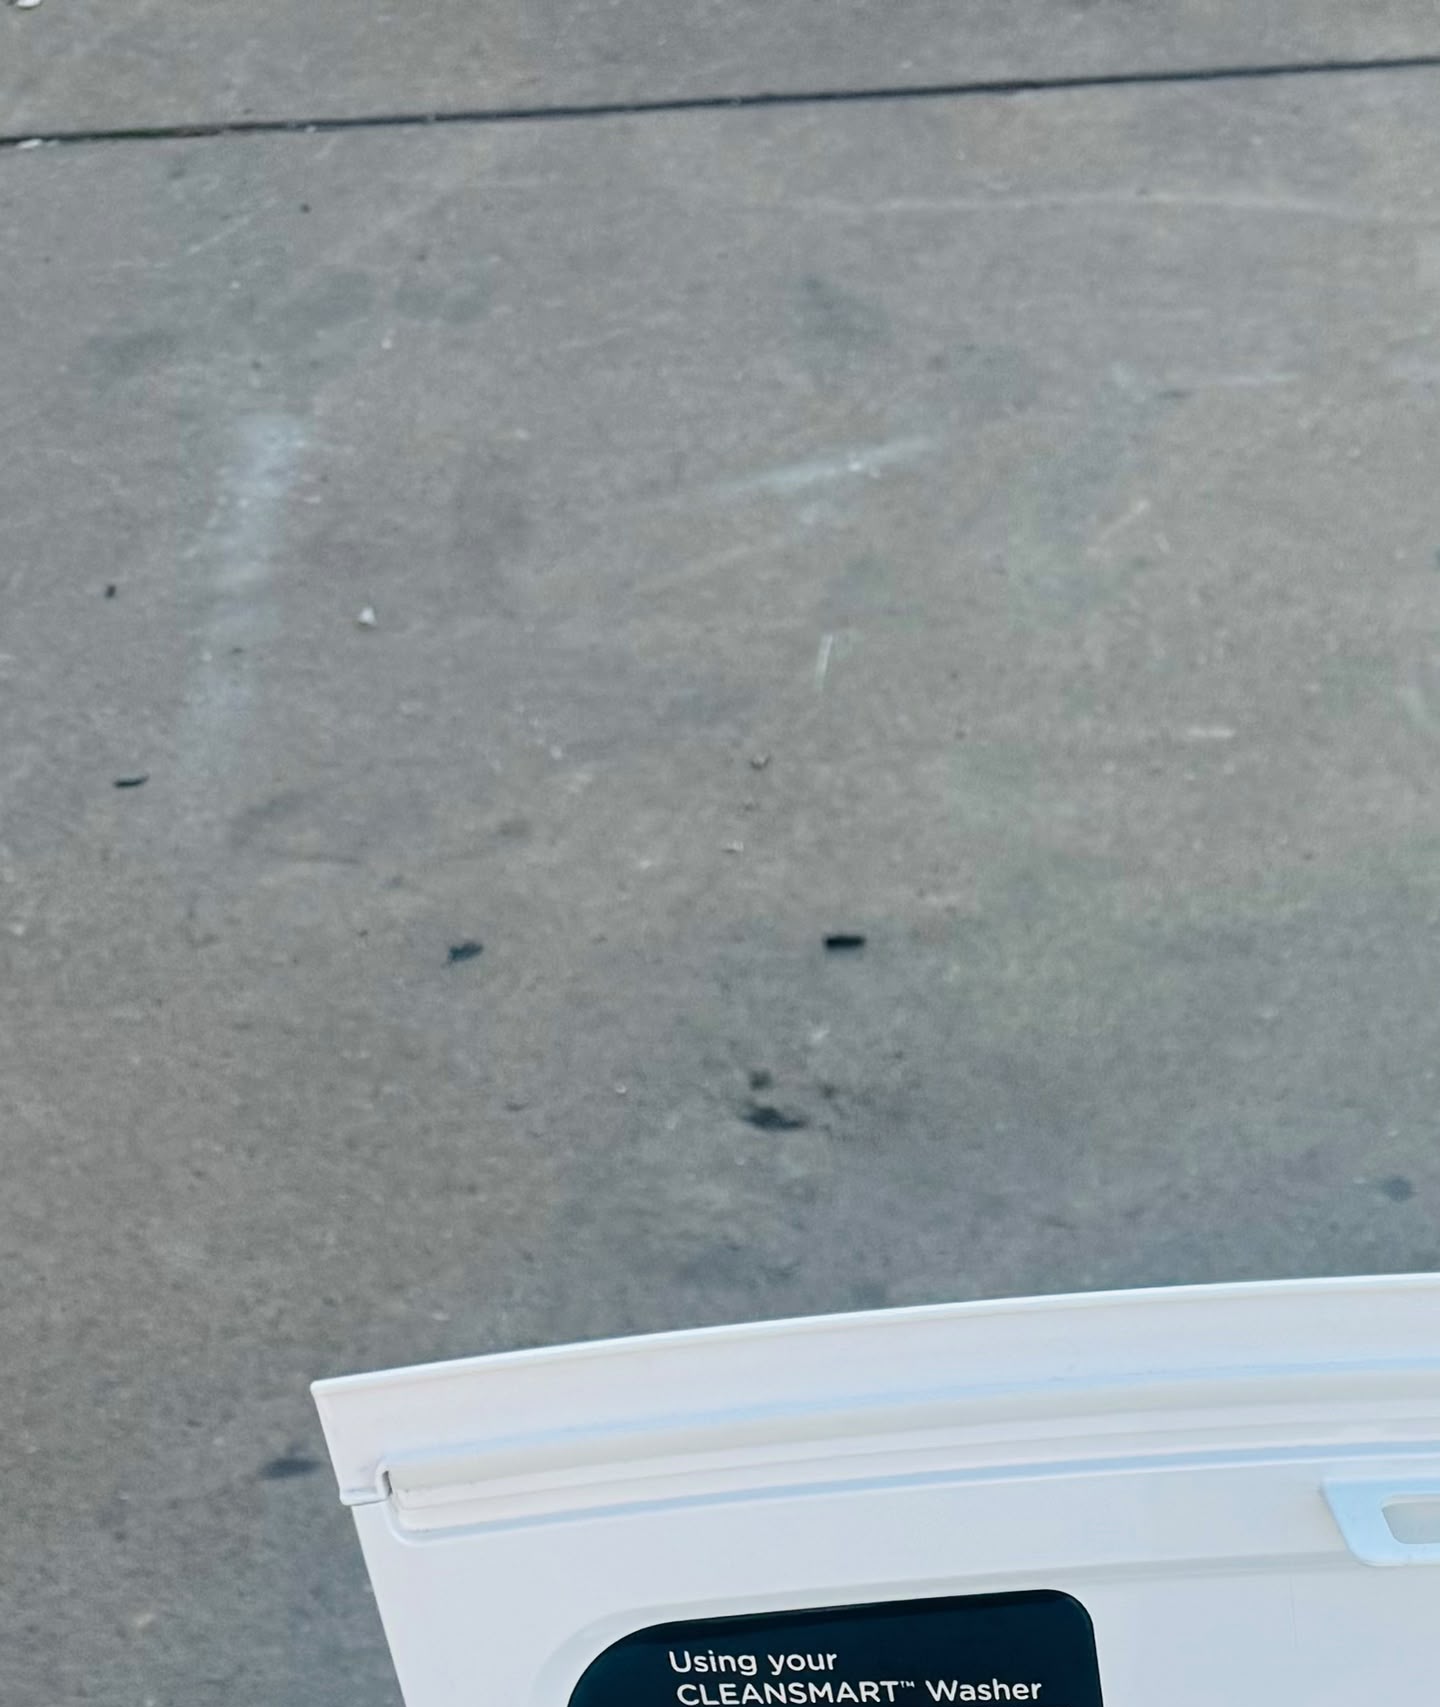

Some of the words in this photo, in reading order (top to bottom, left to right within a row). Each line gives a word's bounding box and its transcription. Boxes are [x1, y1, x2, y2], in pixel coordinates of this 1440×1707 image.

[668, 1649, 758, 1674] Using
[766, 1652, 838, 1674] your
[924, 1677, 1042, 1702] Washer
